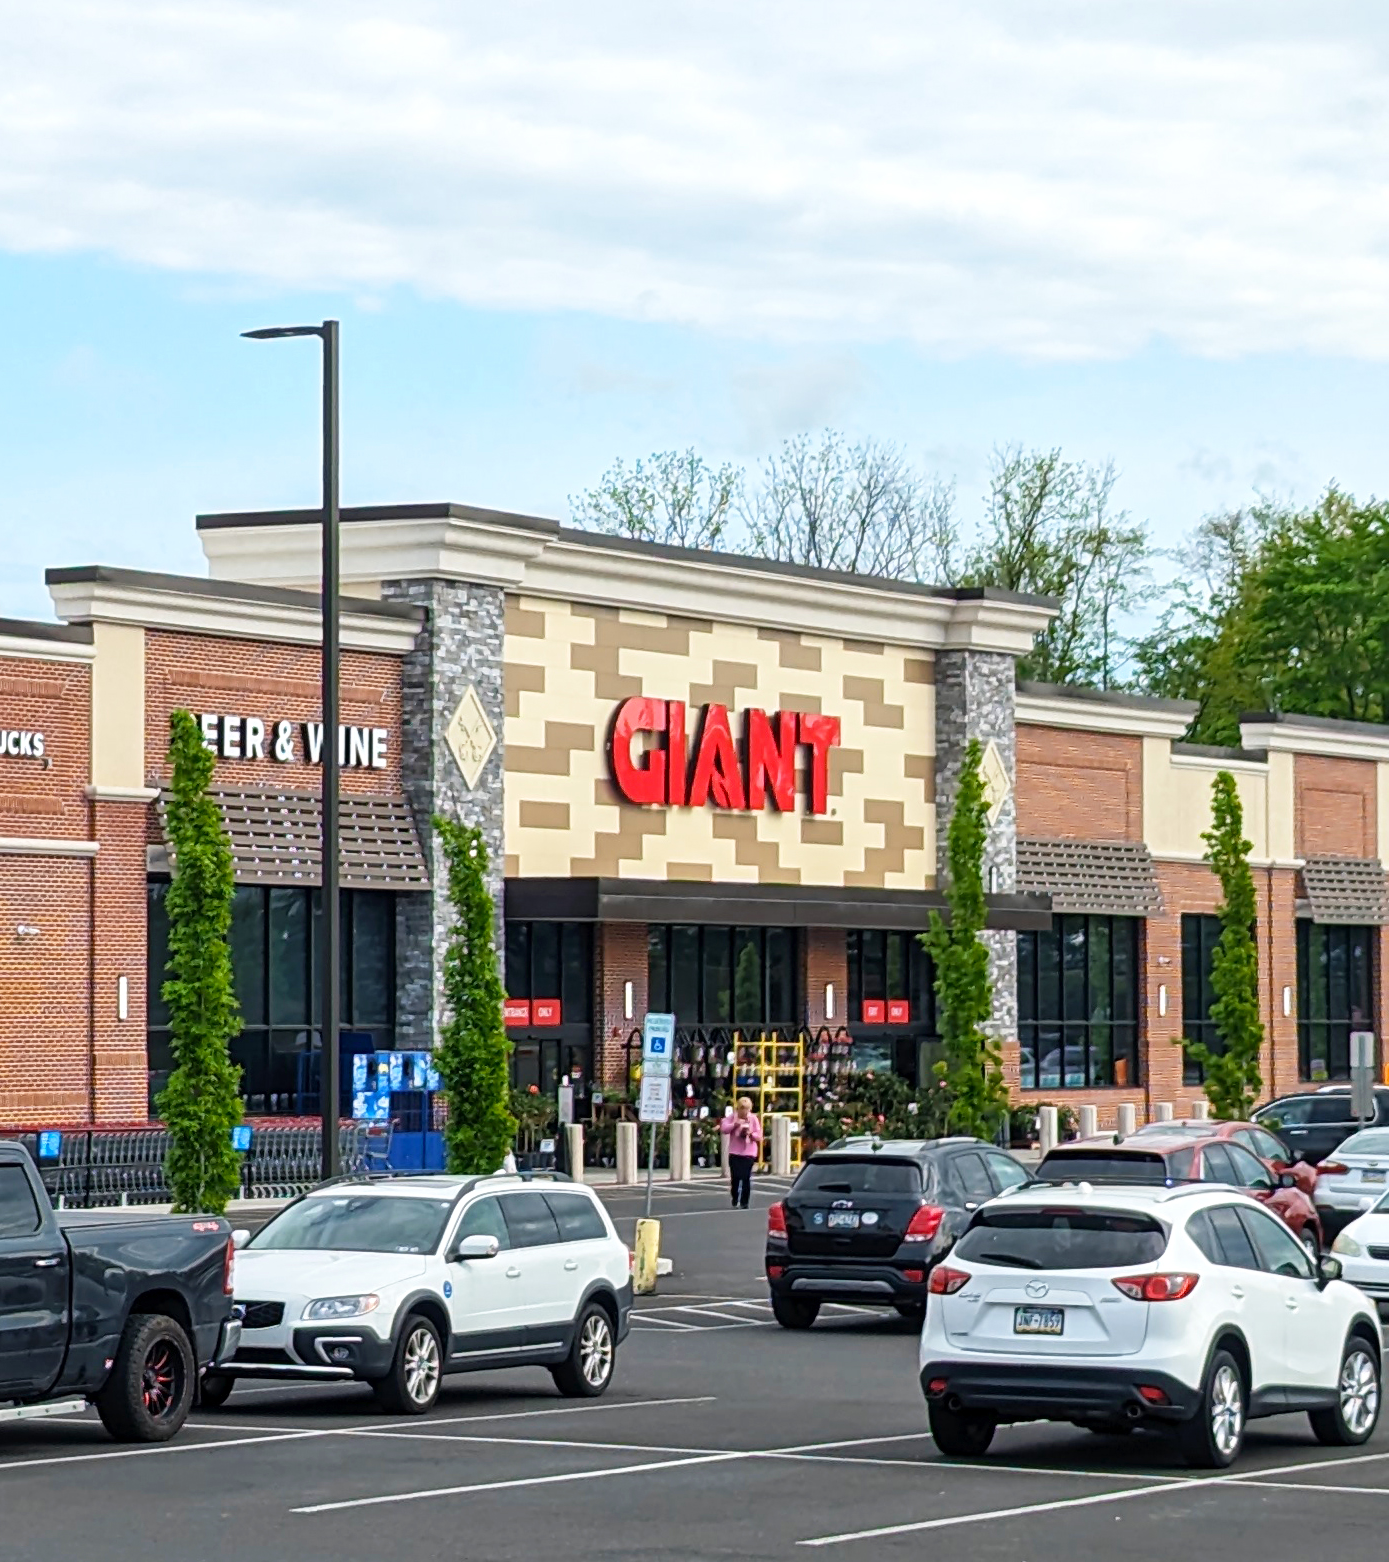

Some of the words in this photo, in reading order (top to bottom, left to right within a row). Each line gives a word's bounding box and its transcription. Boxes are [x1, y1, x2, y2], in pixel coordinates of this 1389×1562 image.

[190, 713, 266, 759] EER
[274, 719, 294, 762] &
[610, 696, 841, 815] GIANT
